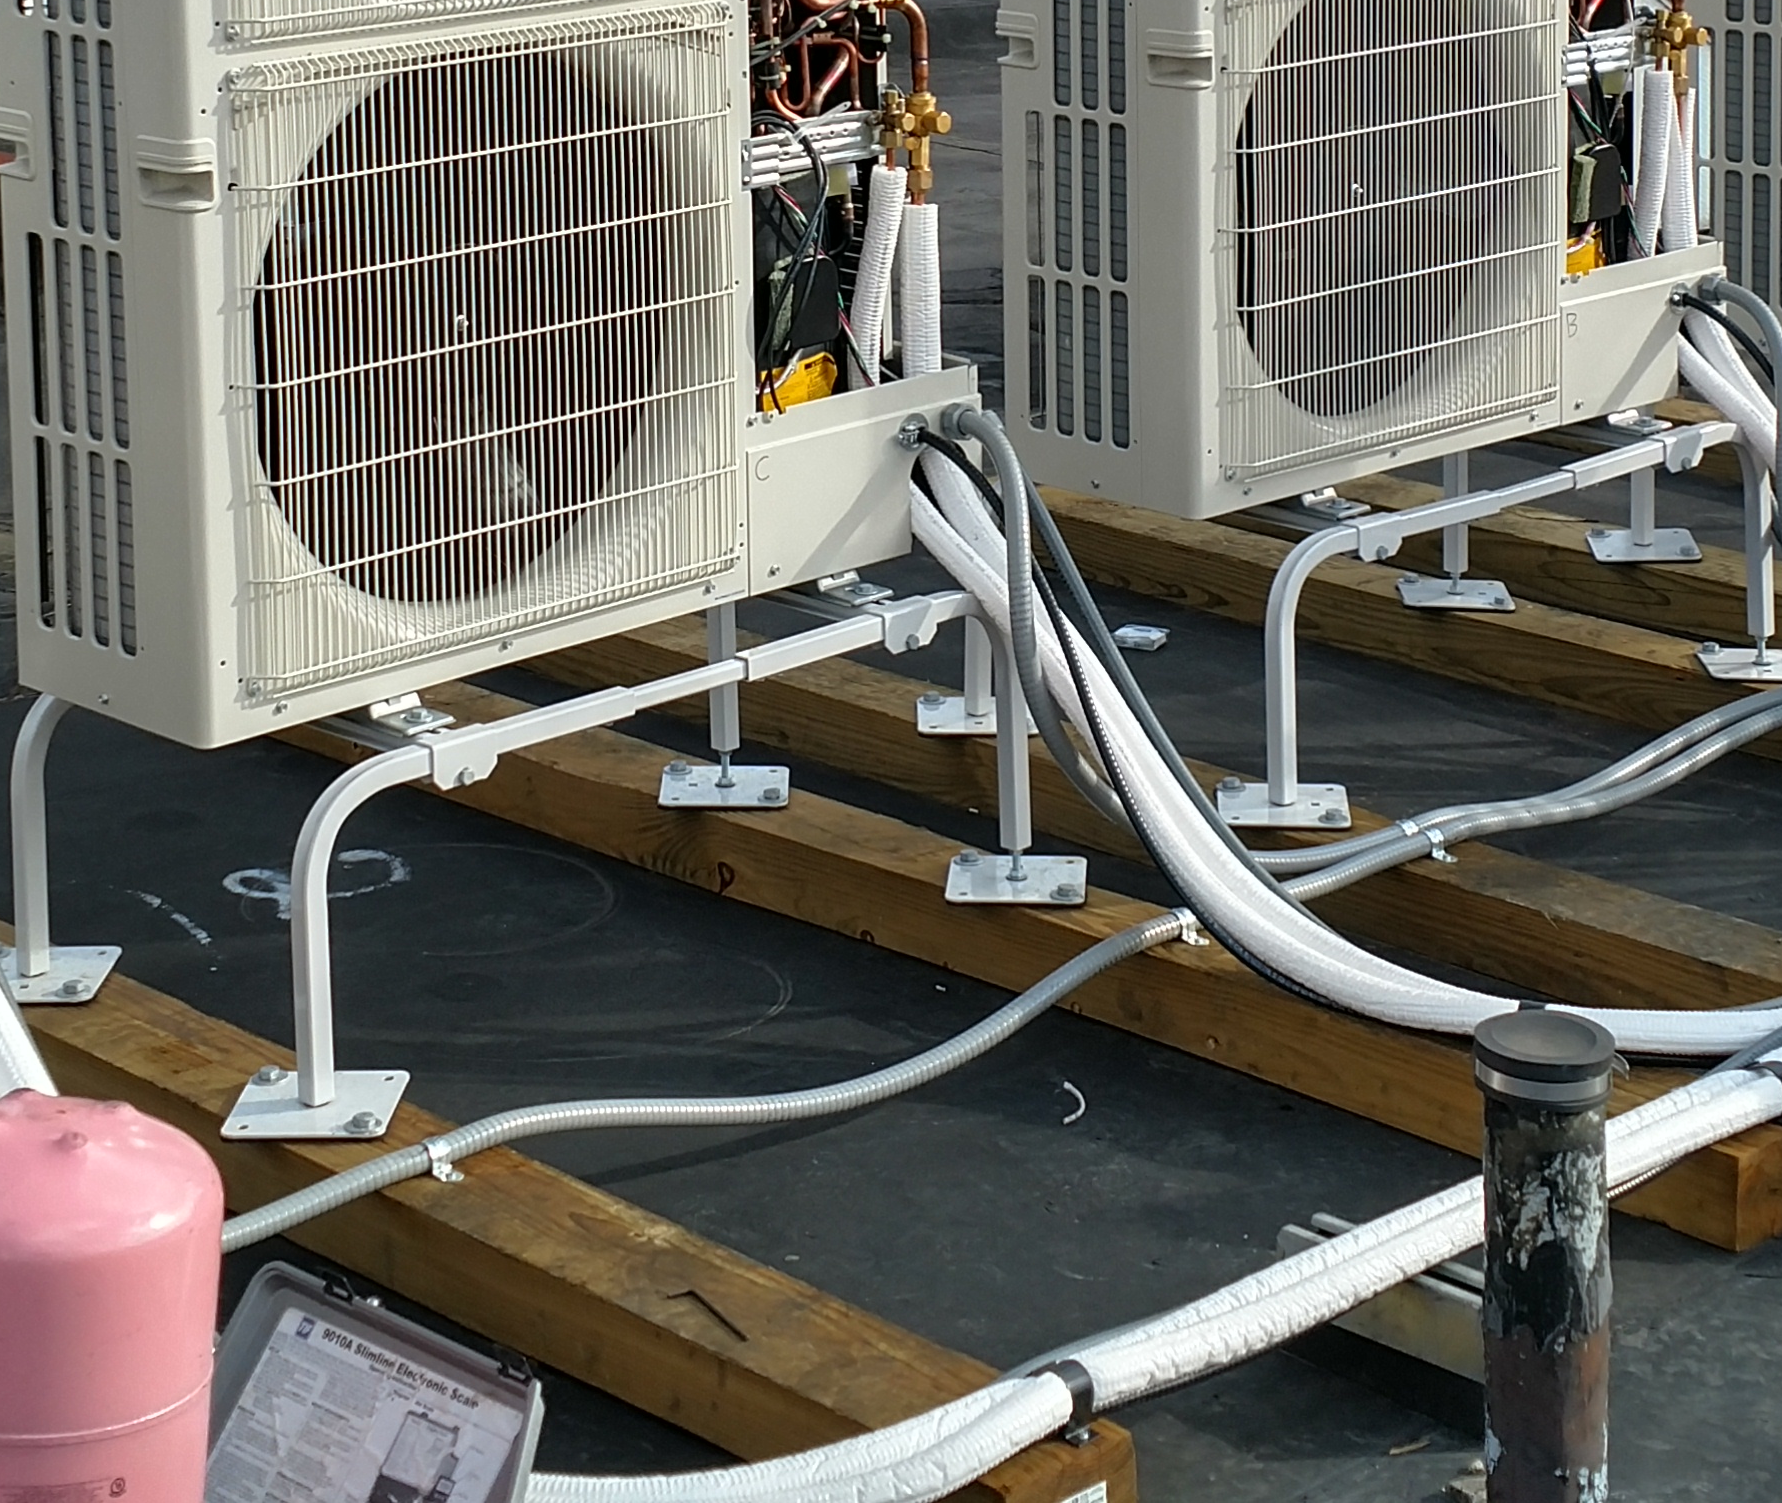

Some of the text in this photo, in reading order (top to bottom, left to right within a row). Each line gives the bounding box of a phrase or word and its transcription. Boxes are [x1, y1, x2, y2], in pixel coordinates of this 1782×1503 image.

[1566, 311, 1579, 338] B
[755, 455, 771, 482] C
[321, 1327, 354, 1353] 9010A
[353, 1343, 396, 1371] Slimline
[395, 1362, 448, 1397] Electronic
[450, 1387, 481, 1410] Scale
